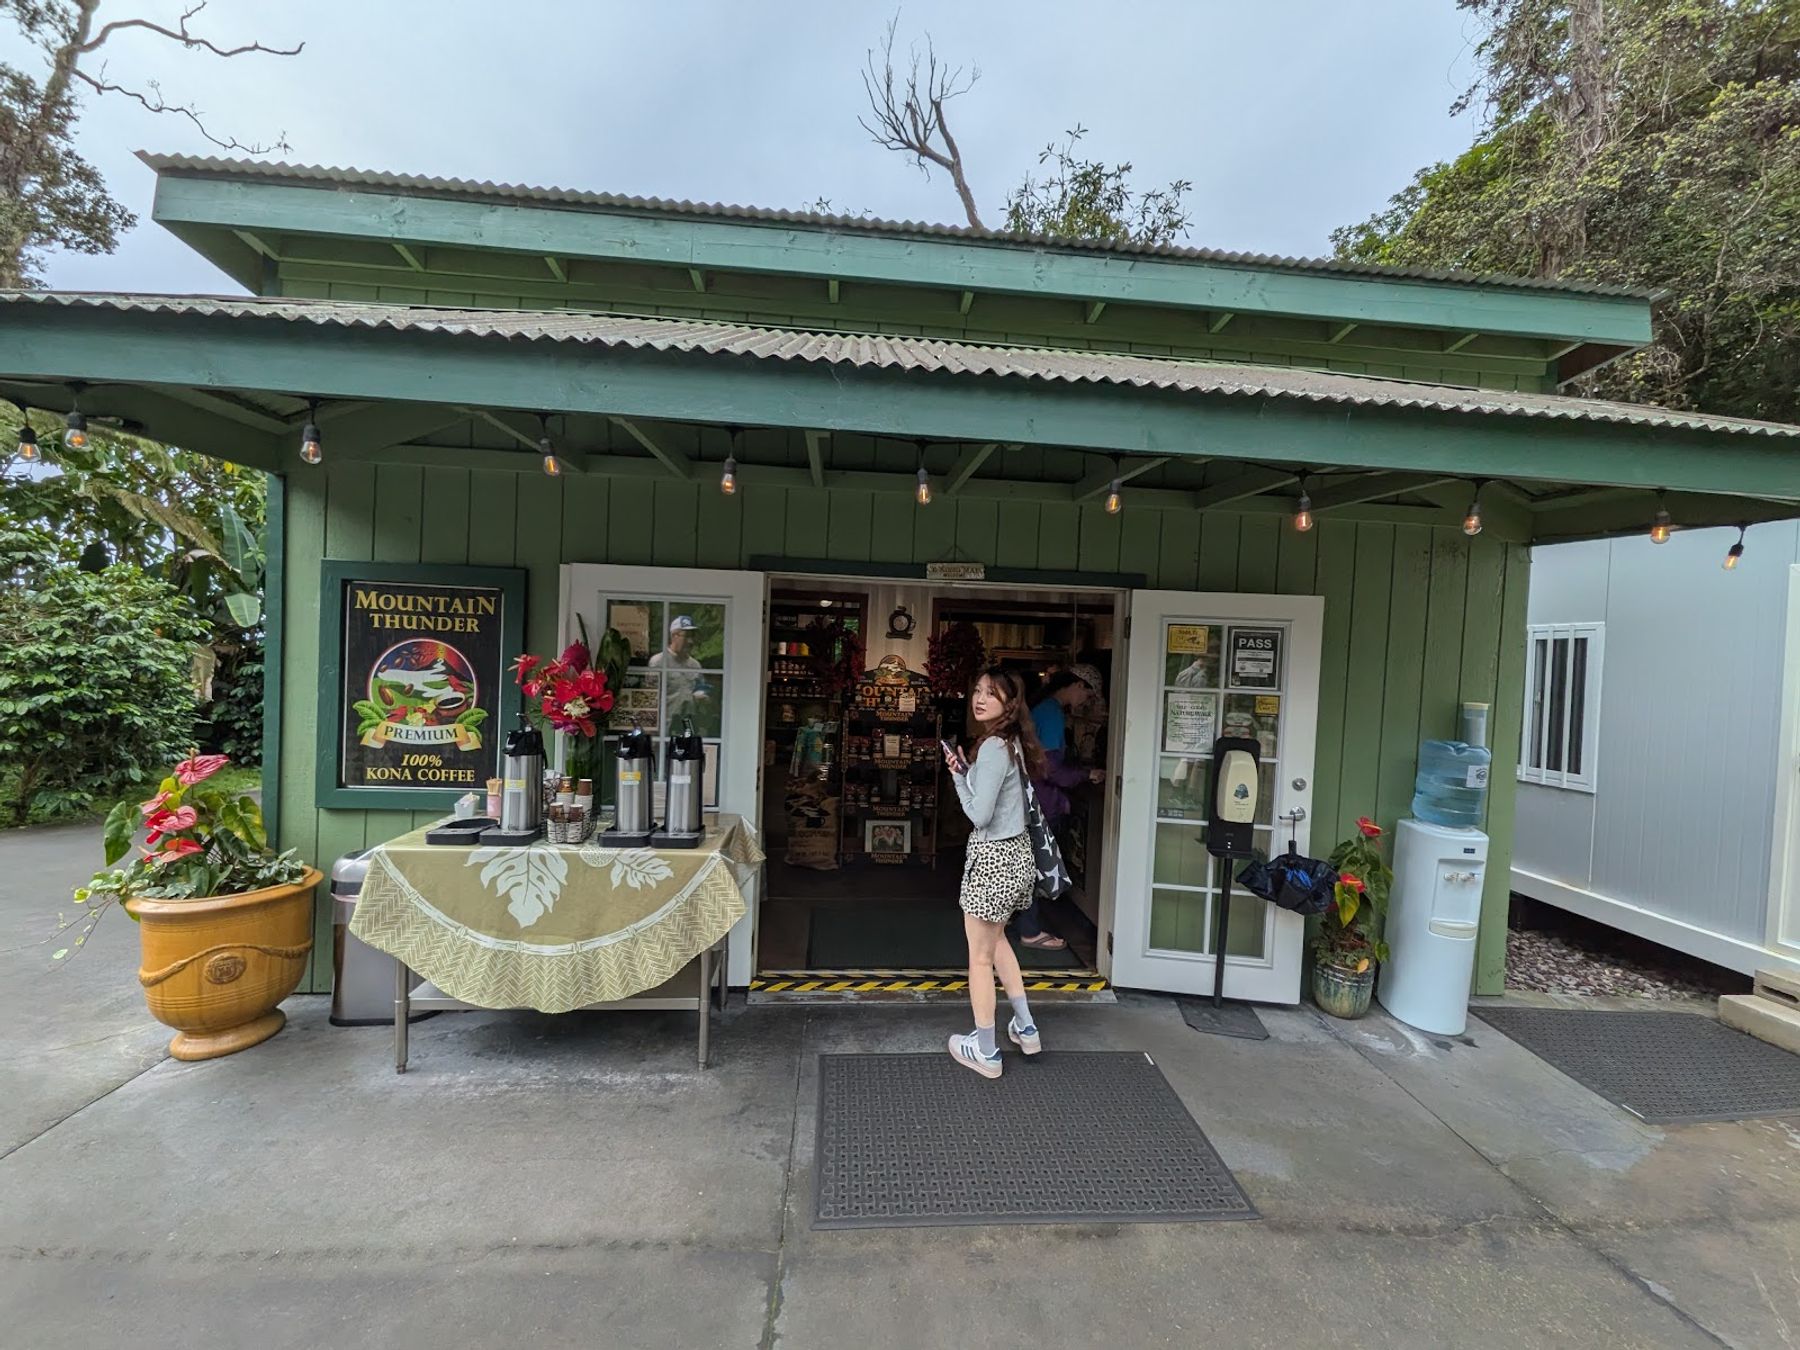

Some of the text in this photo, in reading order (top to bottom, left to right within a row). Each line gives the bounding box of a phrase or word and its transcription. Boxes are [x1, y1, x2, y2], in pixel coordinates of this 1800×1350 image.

[354, 589, 497, 616] MOUNTAIN
[369, 612, 481, 633] THUNDER
[1238, 637, 1273, 649] PASS
[383, 725, 459, 742] PREMIUM
[400, 753, 443, 767] 100%
[366, 767, 475, 782] KONA COFFEE
